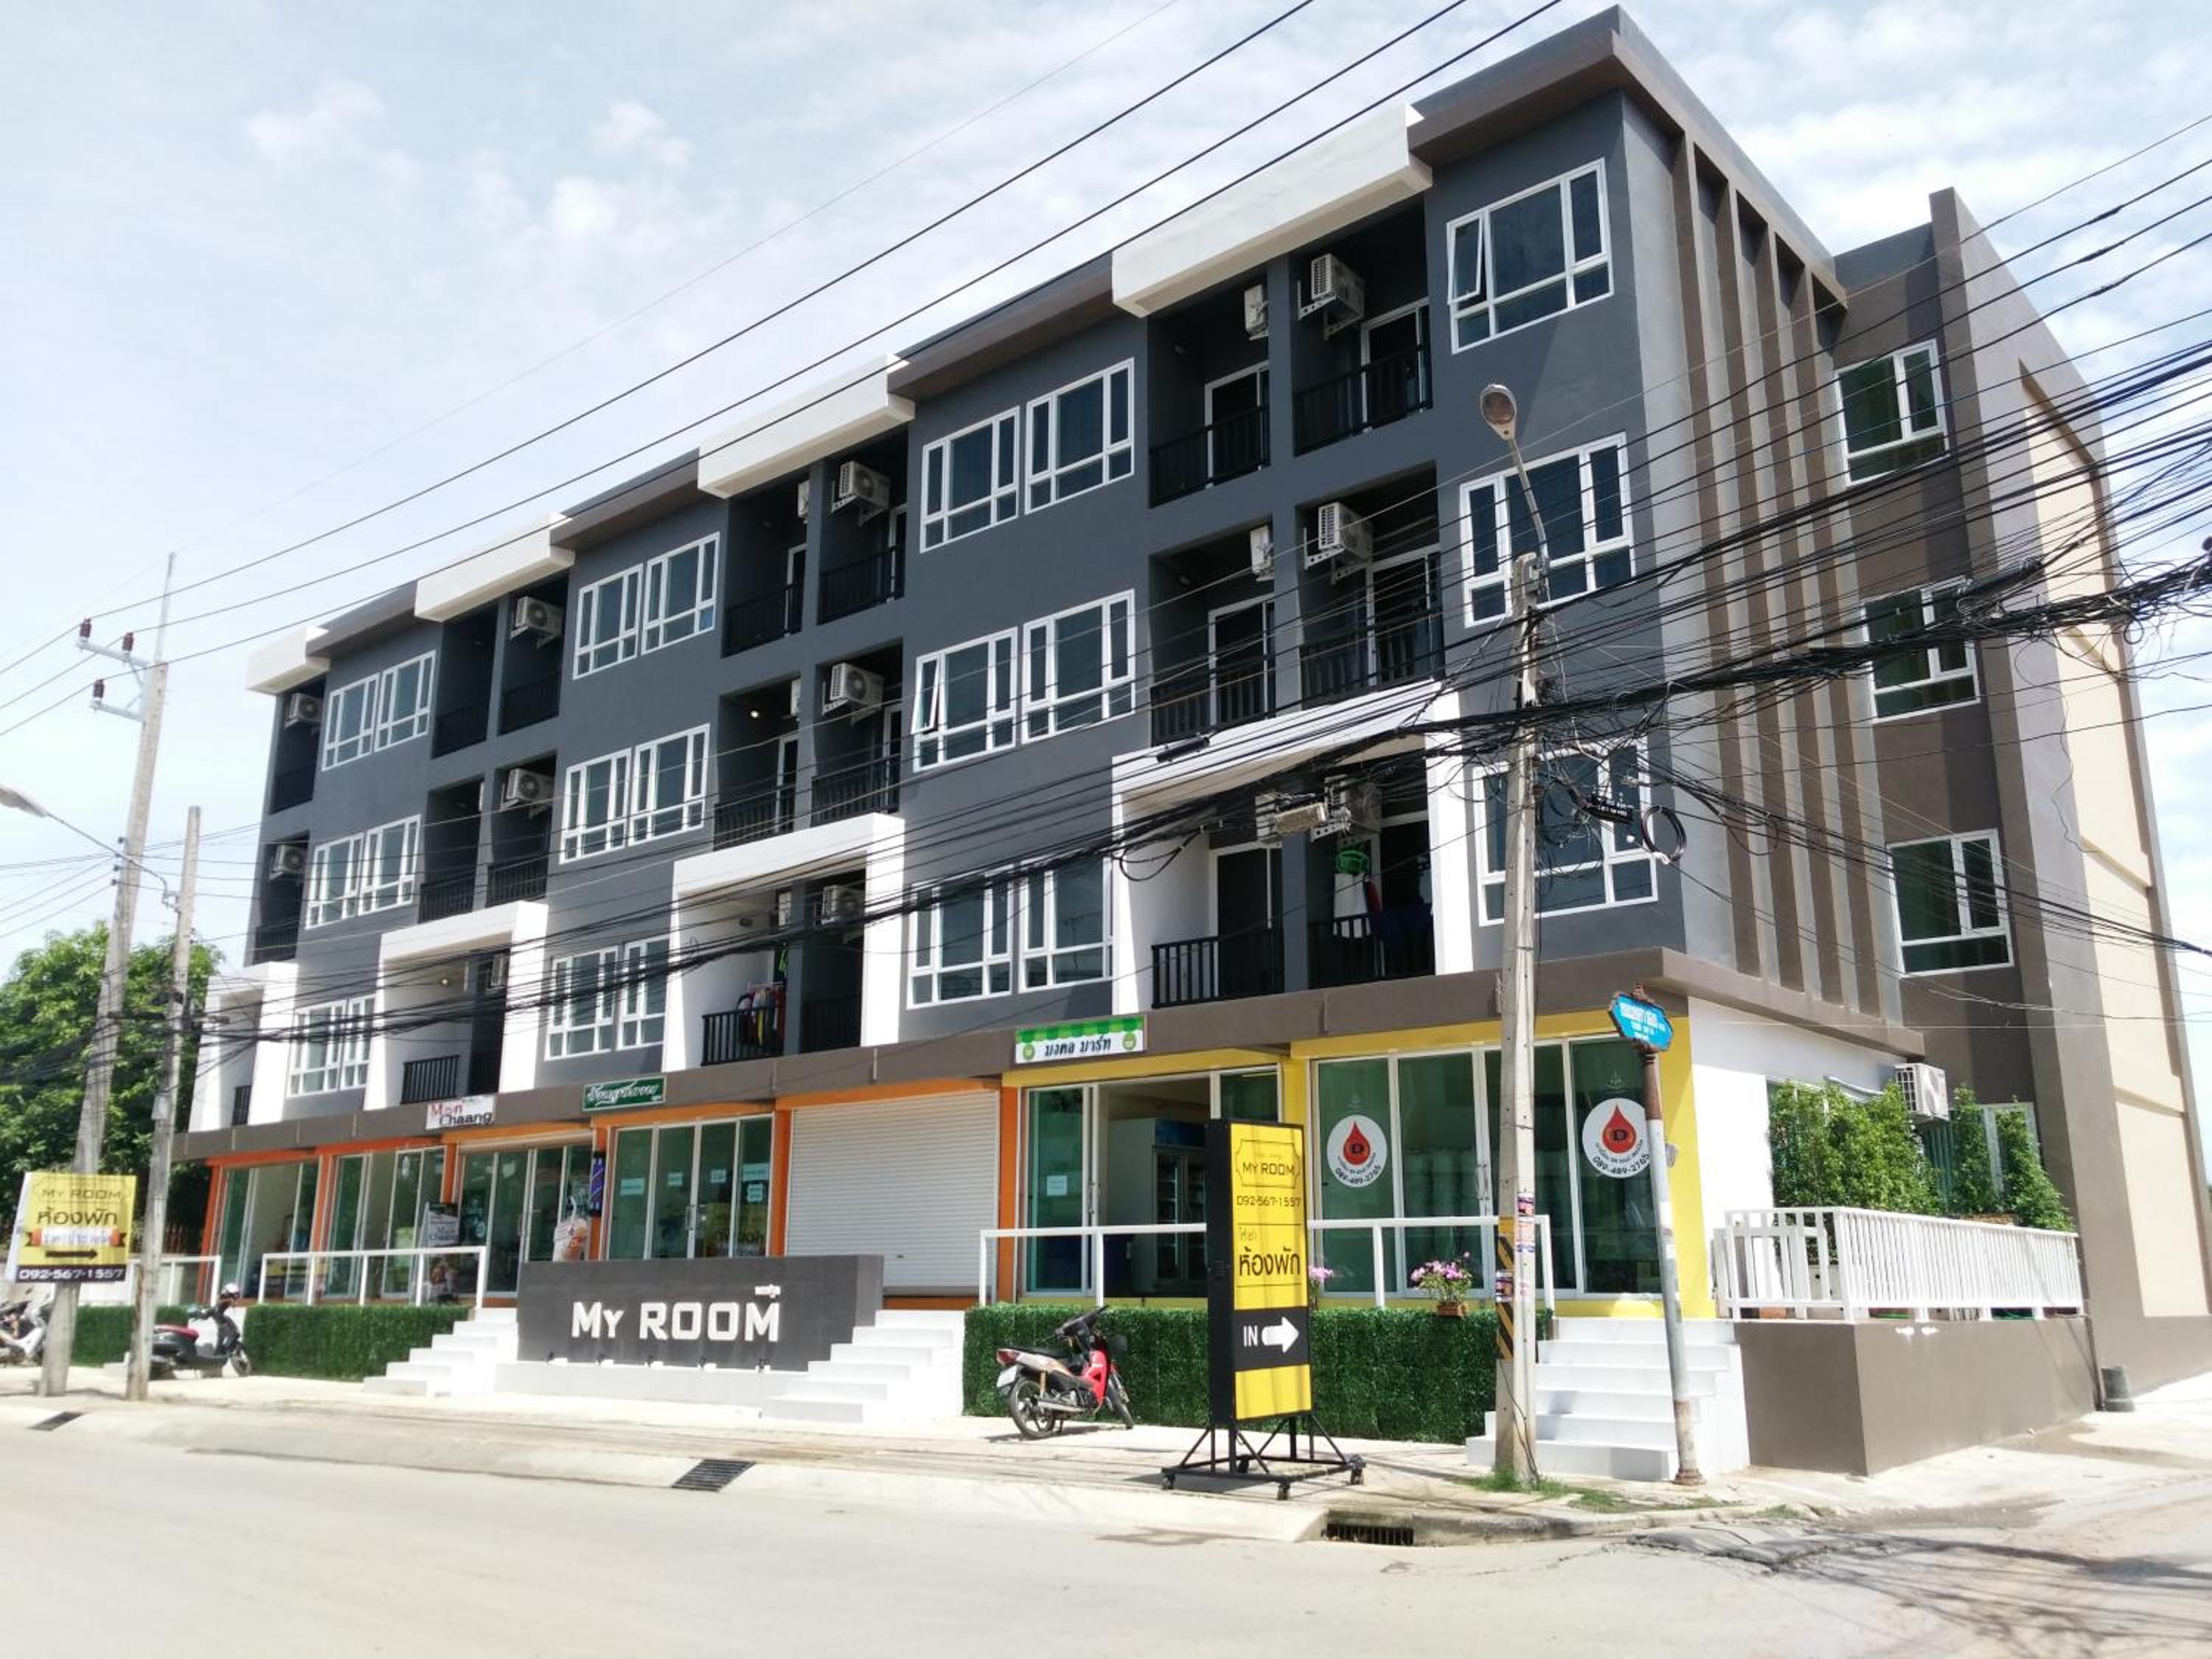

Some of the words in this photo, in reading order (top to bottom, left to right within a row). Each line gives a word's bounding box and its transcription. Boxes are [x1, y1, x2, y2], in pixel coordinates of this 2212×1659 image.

[1261, 1163, 1295, 1176] ROOM
[70, 1189, 121, 1200] ROOM
[1237, 1195, 1301, 1207] 092-567-1557
[37, 1206, 117, 1225] ห้องพัก
[1239, 1246, 1301, 1276] ห้องพัก
[18, 1268, 123, 1279] 092-567-1557
[639, 1301, 780, 1342] ROOM
[1243, 1325, 1259, 1348] IN
